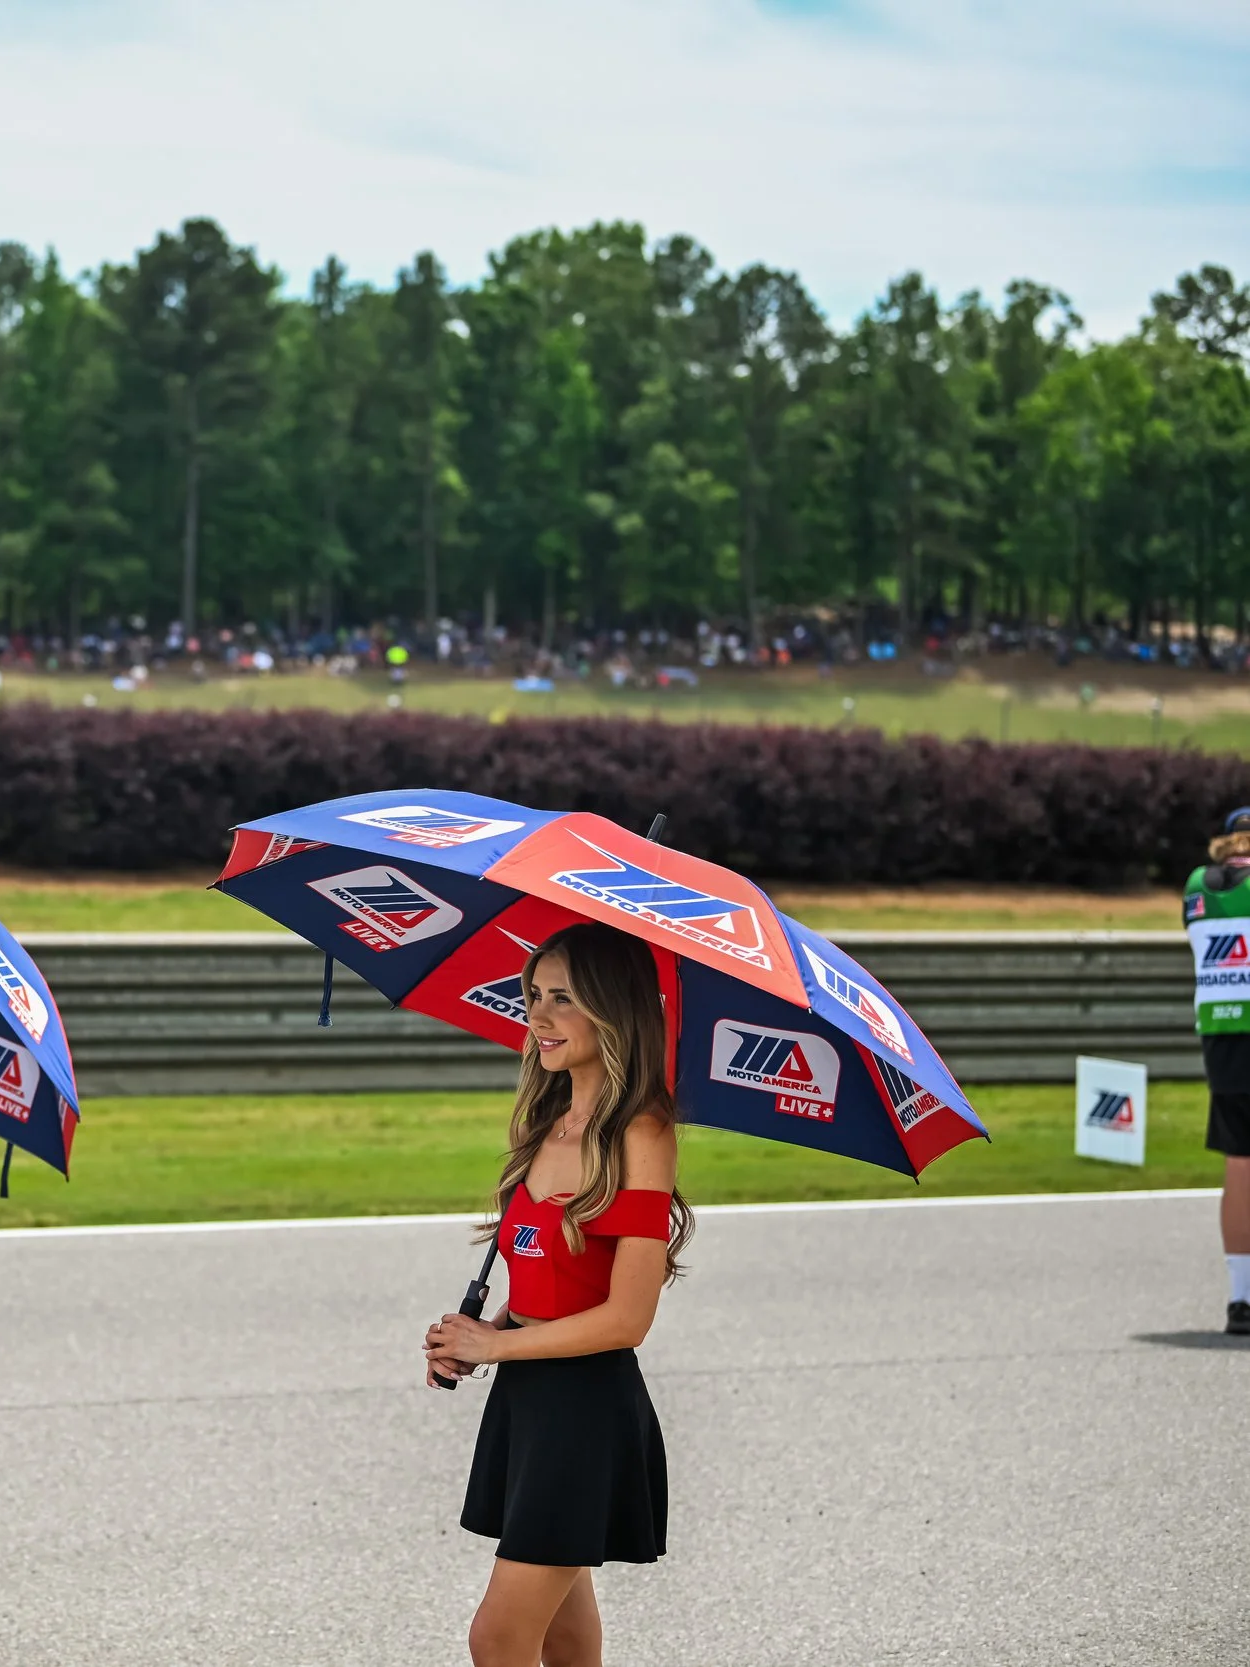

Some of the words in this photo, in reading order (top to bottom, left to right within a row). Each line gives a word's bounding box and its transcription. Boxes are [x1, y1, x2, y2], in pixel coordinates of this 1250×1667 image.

[366, 817, 465, 840] MOTOAMERICA
[329, 887, 407, 938] MOTOAMERICA
[556, 875, 766, 966] MOTOAMERICA
[726, 1068, 822, 1095] MOTOAMERICA
